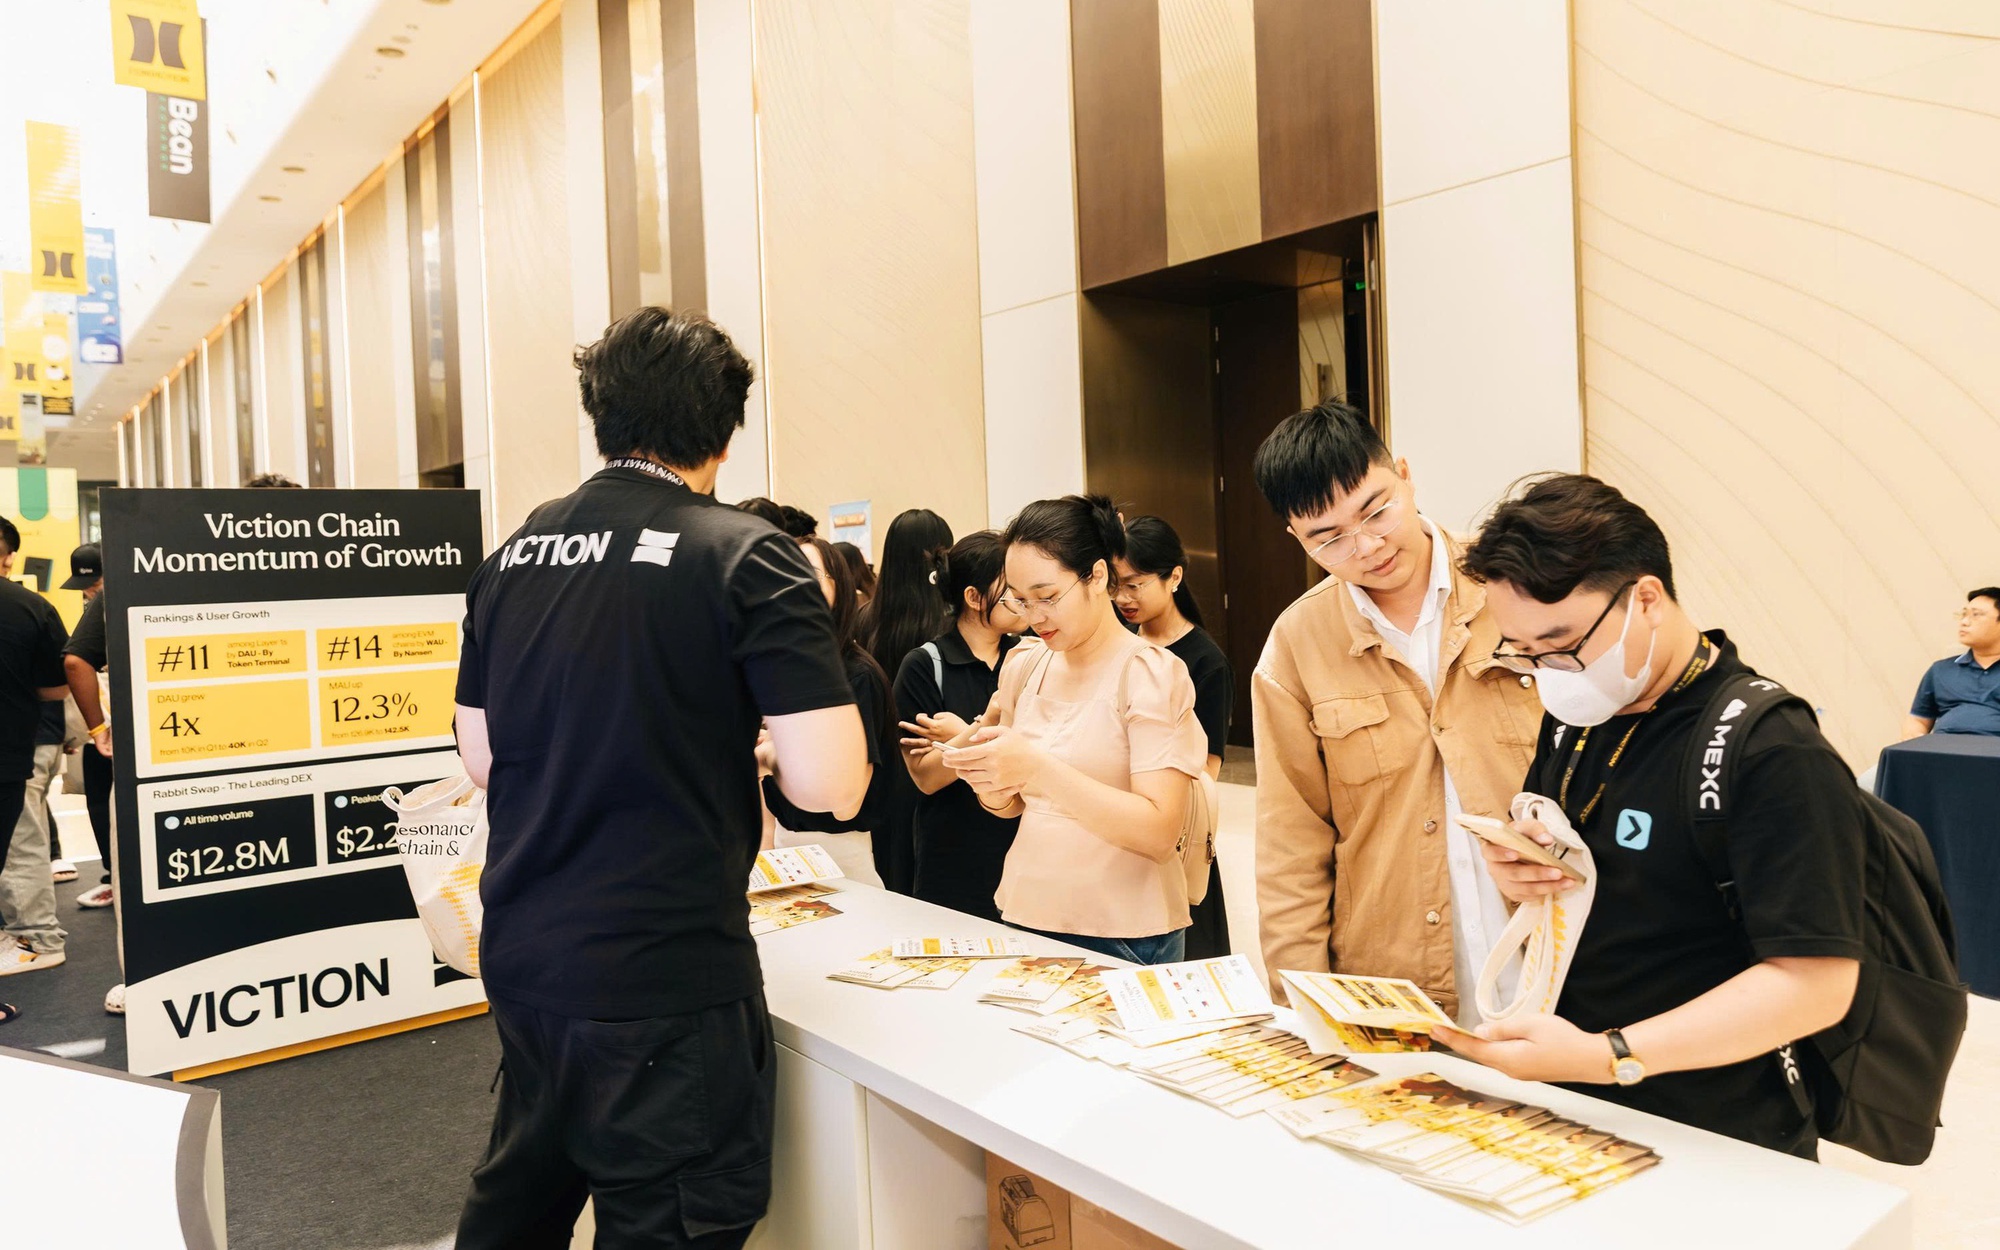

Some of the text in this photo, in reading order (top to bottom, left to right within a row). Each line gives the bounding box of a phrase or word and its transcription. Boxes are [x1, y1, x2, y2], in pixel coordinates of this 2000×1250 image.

[167, 97, 198, 175] Bean
[623, 458, 657, 475] WHAT
[657, 467, 684, 486] OWN
[203, 512, 400, 539] Viction Chain
[133, 541, 462, 573] Momentum of Growth
[144, 610, 270, 624] Rankings & User Growth
[157, 644, 209, 673] #11
[237, 650, 257, 658] DAU
[262, 649, 273, 657] By
[327, 634, 382, 662] #14
[404, 649, 433, 657] Nansen
[227, 658, 290, 669] Token Terminal
[329, 681, 363, 690] MAU up
[157, 693, 205, 704] DAU grew
[331, 691, 418, 723] 12.3%
[159, 711, 201, 737] 4x
[331, 731, 349, 740] from
[159, 748, 179, 756] from
[228, 741, 246, 750] 40K
[256, 738, 269, 747] Q2
[1699, 724, 1733, 810] MEXC
[153, 787, 188, 799] Rabbit
[190, 785, 220, 796] Swap
[227, 781, 247, 791] The
[249, 778, 290, 789] Leading
[291, 773, 313, 784] DEX
[183, 810, 254, 826] All time volume
[398, 839, 460, 857] chain &
[168, 836, 290, 883] $12.8M
[162, 957, 390, 1039] VICTION
[1778, 1041, 1800, 1085] XC
